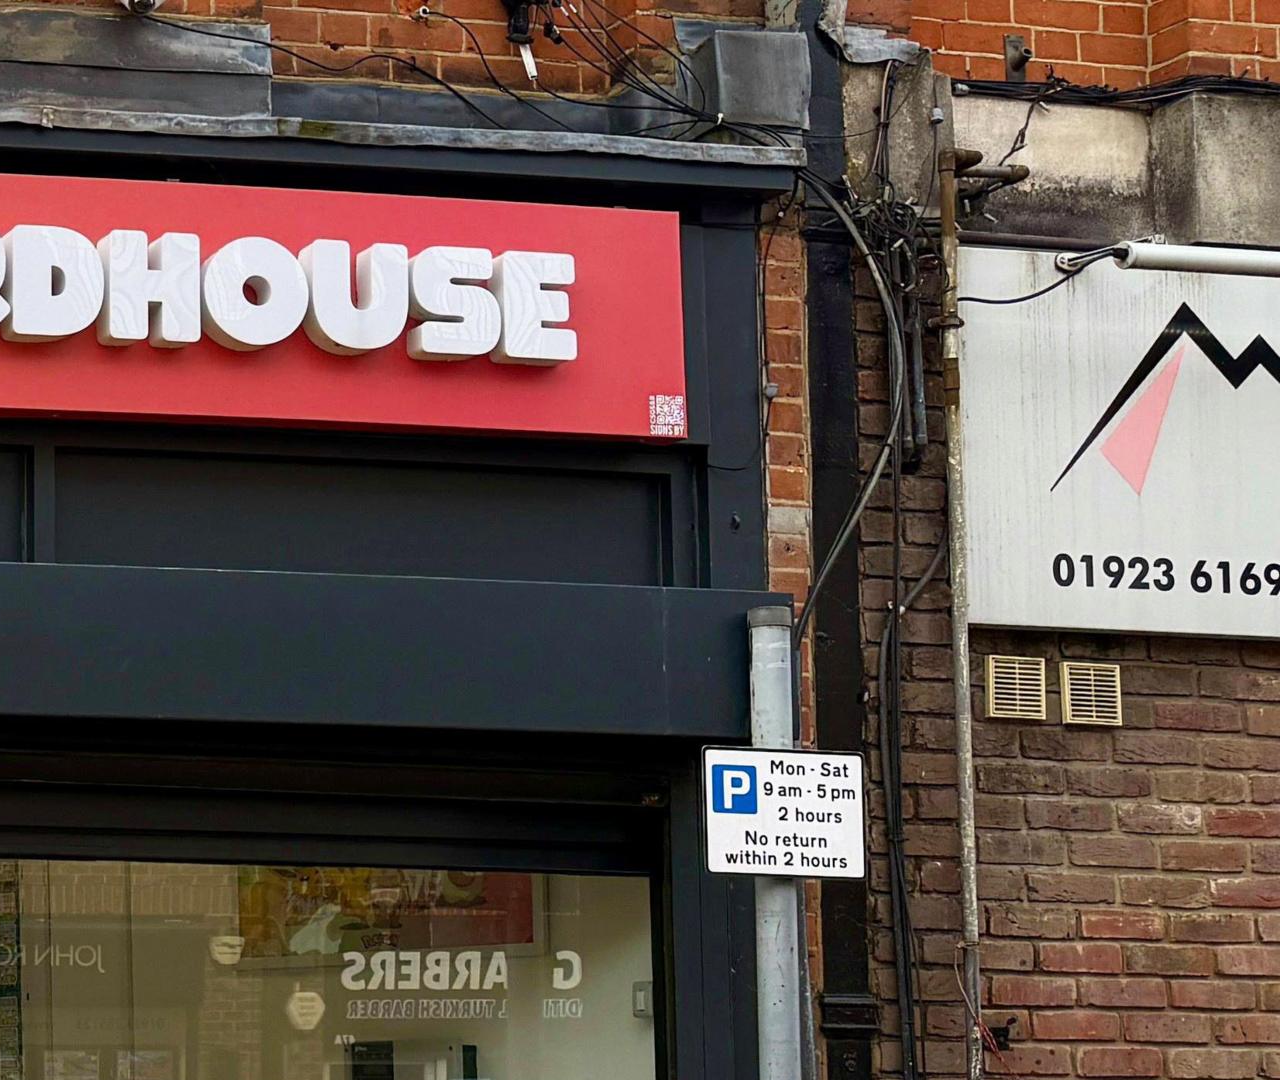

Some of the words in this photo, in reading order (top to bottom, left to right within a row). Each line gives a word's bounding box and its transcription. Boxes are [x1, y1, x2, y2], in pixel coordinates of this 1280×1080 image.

[1052, 553, 1175, 591] 01923
[770, 760, 806, 776] Mon
[820, 762, 849, 778] Sat
[722, 769, 751, 810] P
[763, 781, 773, 796] 9
[777, 785, 802, 798] am
[817, 783, 827, 799] 5
[830, 788, 856, 802] pm
[778, 806, 789, 822] 2
[795, 807, 843, 824] hours
[744, 830, 769, 846] No
[775, 832, 828, 849] return
[725, 850, 778, 866] within
[783, 851, 794, 866] 2
[800, 852, 848, 869] hours
